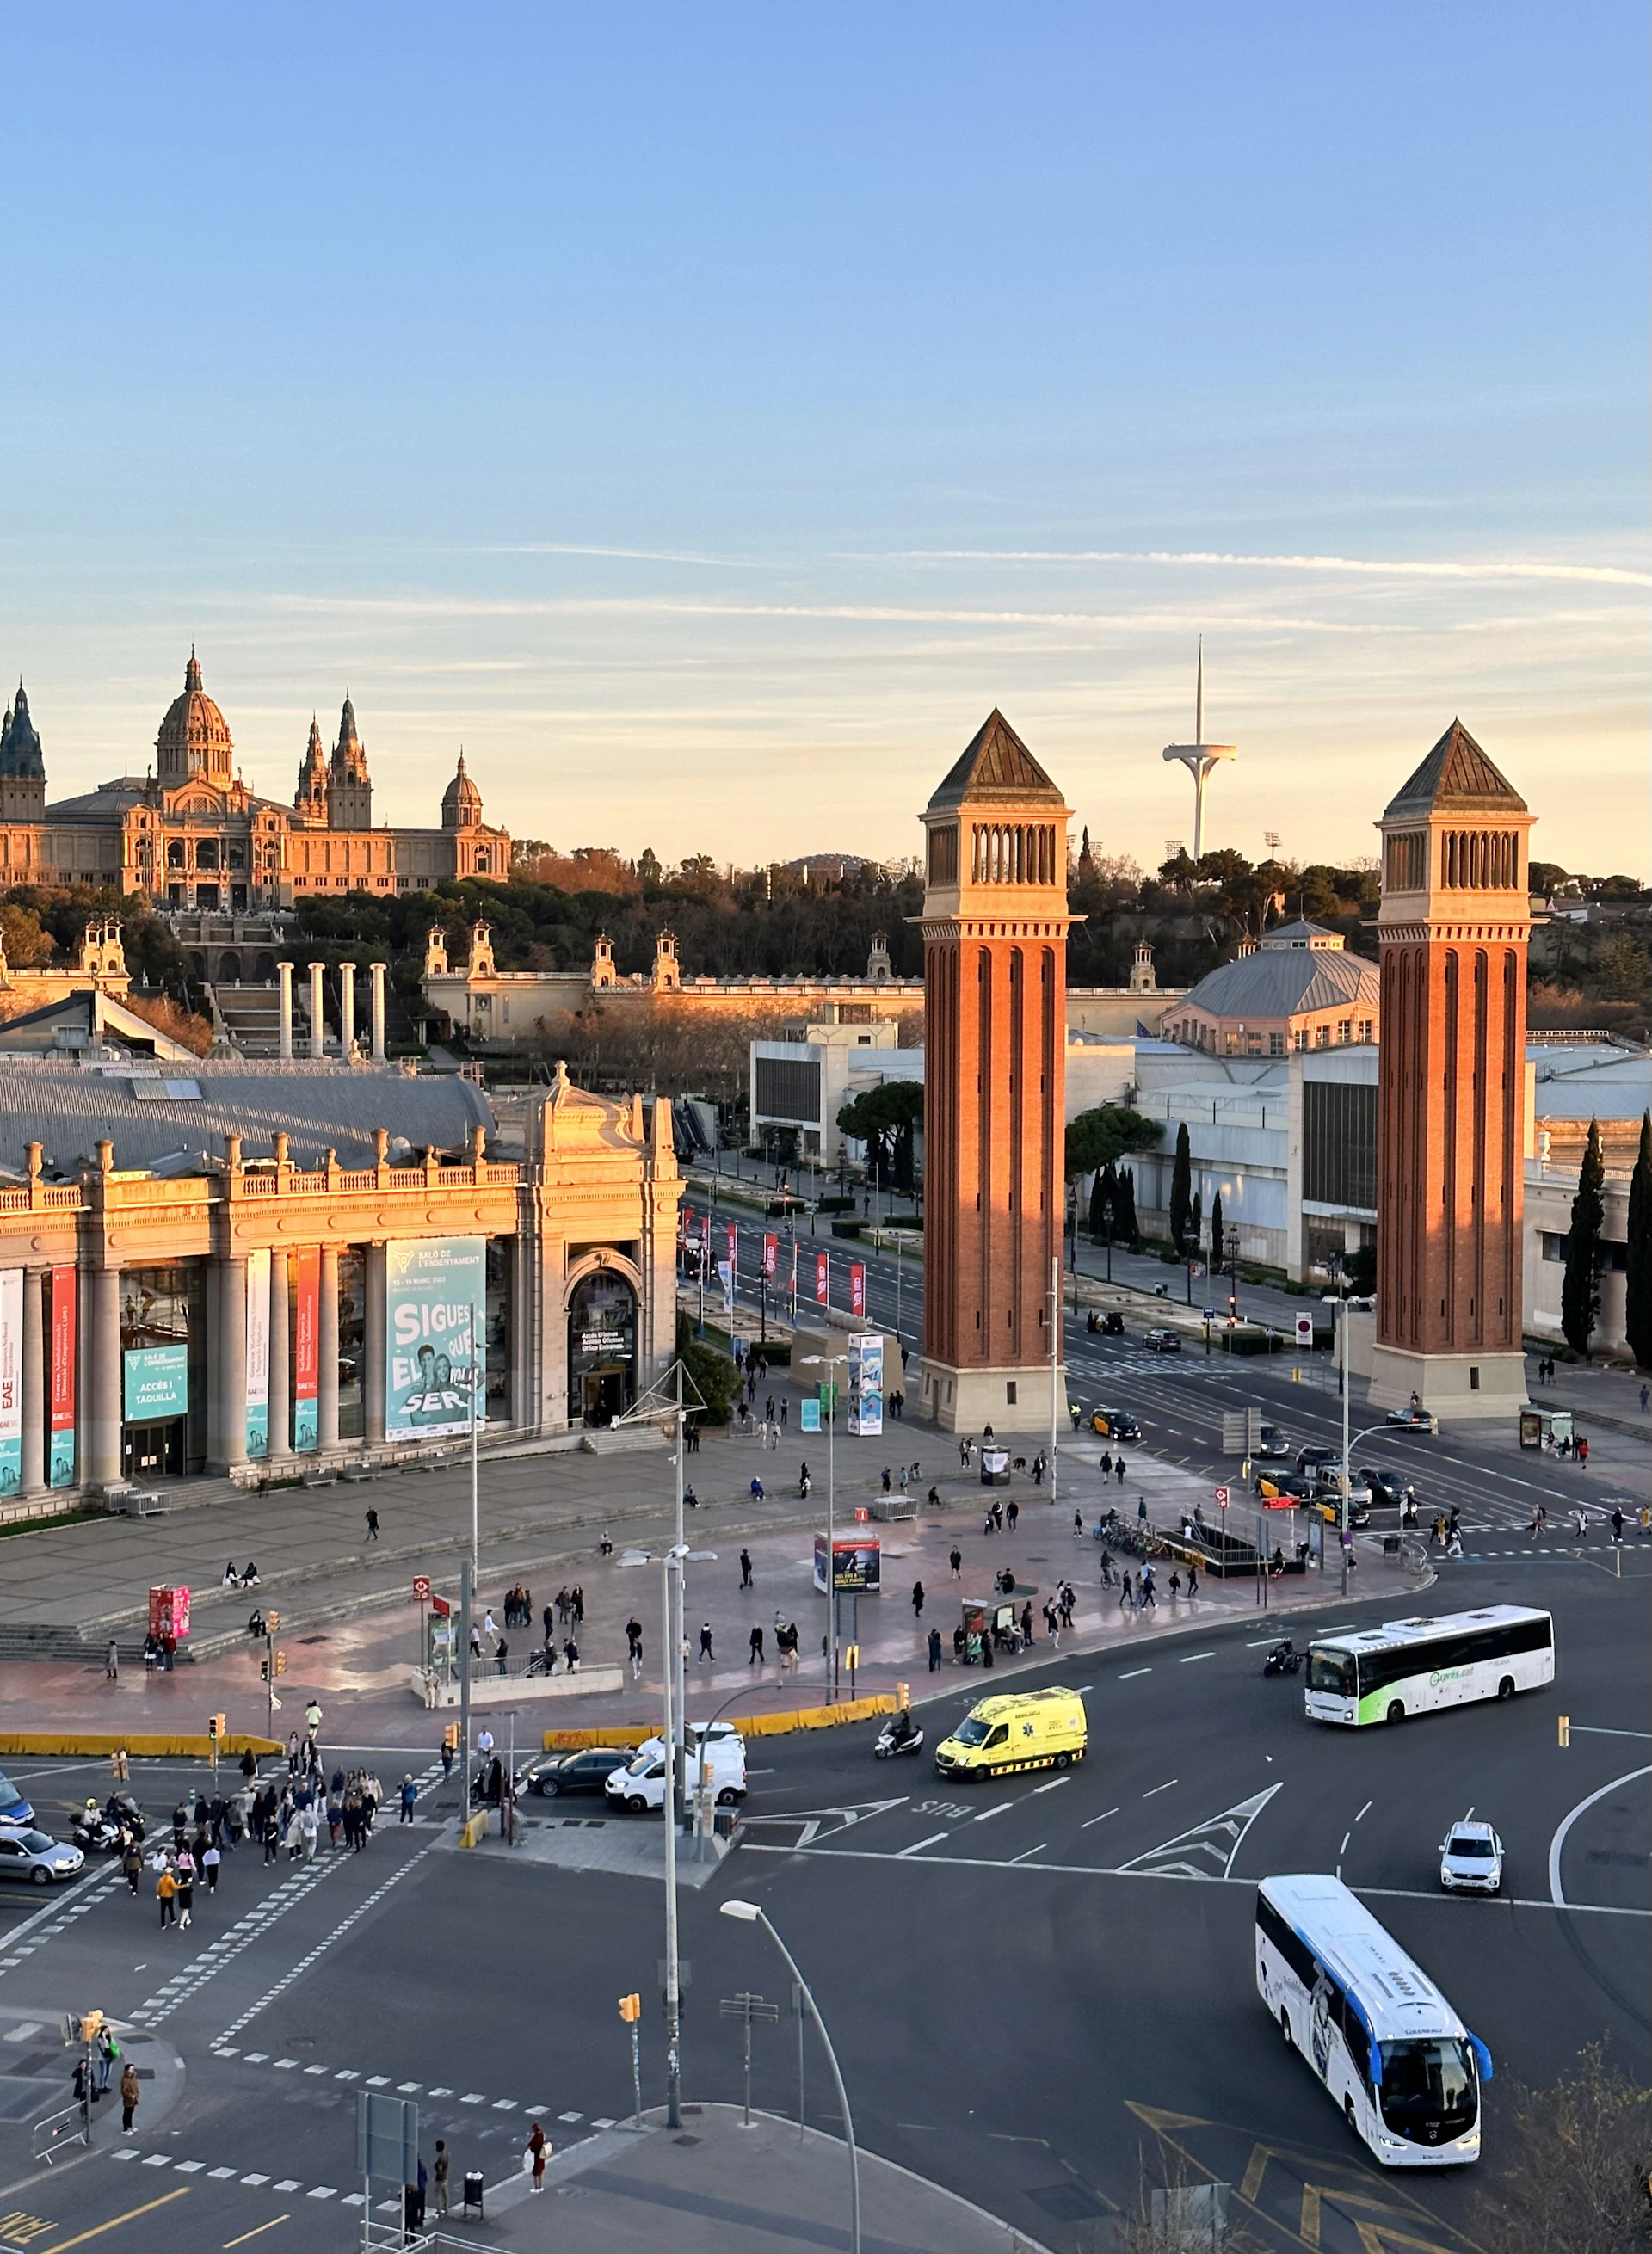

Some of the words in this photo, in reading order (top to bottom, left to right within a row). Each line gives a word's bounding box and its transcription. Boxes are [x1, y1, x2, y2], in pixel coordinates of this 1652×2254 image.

[418, 1249, 439, 1260] SALÓ
[418, 1256, 479, 1267] L'ENSENYAMENT
[394, 1303, 470, 1346] SIGUES
[448, 1328, 475, 1357] QUE
[392, 1357, 422, 1391] EL
[3, 1381, 13, 1409] EAE
[140, 1380, 168, 1392] ACCÉS
[136, 1392, 177, 1404] TAQUILLA
[398, 1391, 469, 1414] SER
[912, 1800, 976, 1818] BUS
